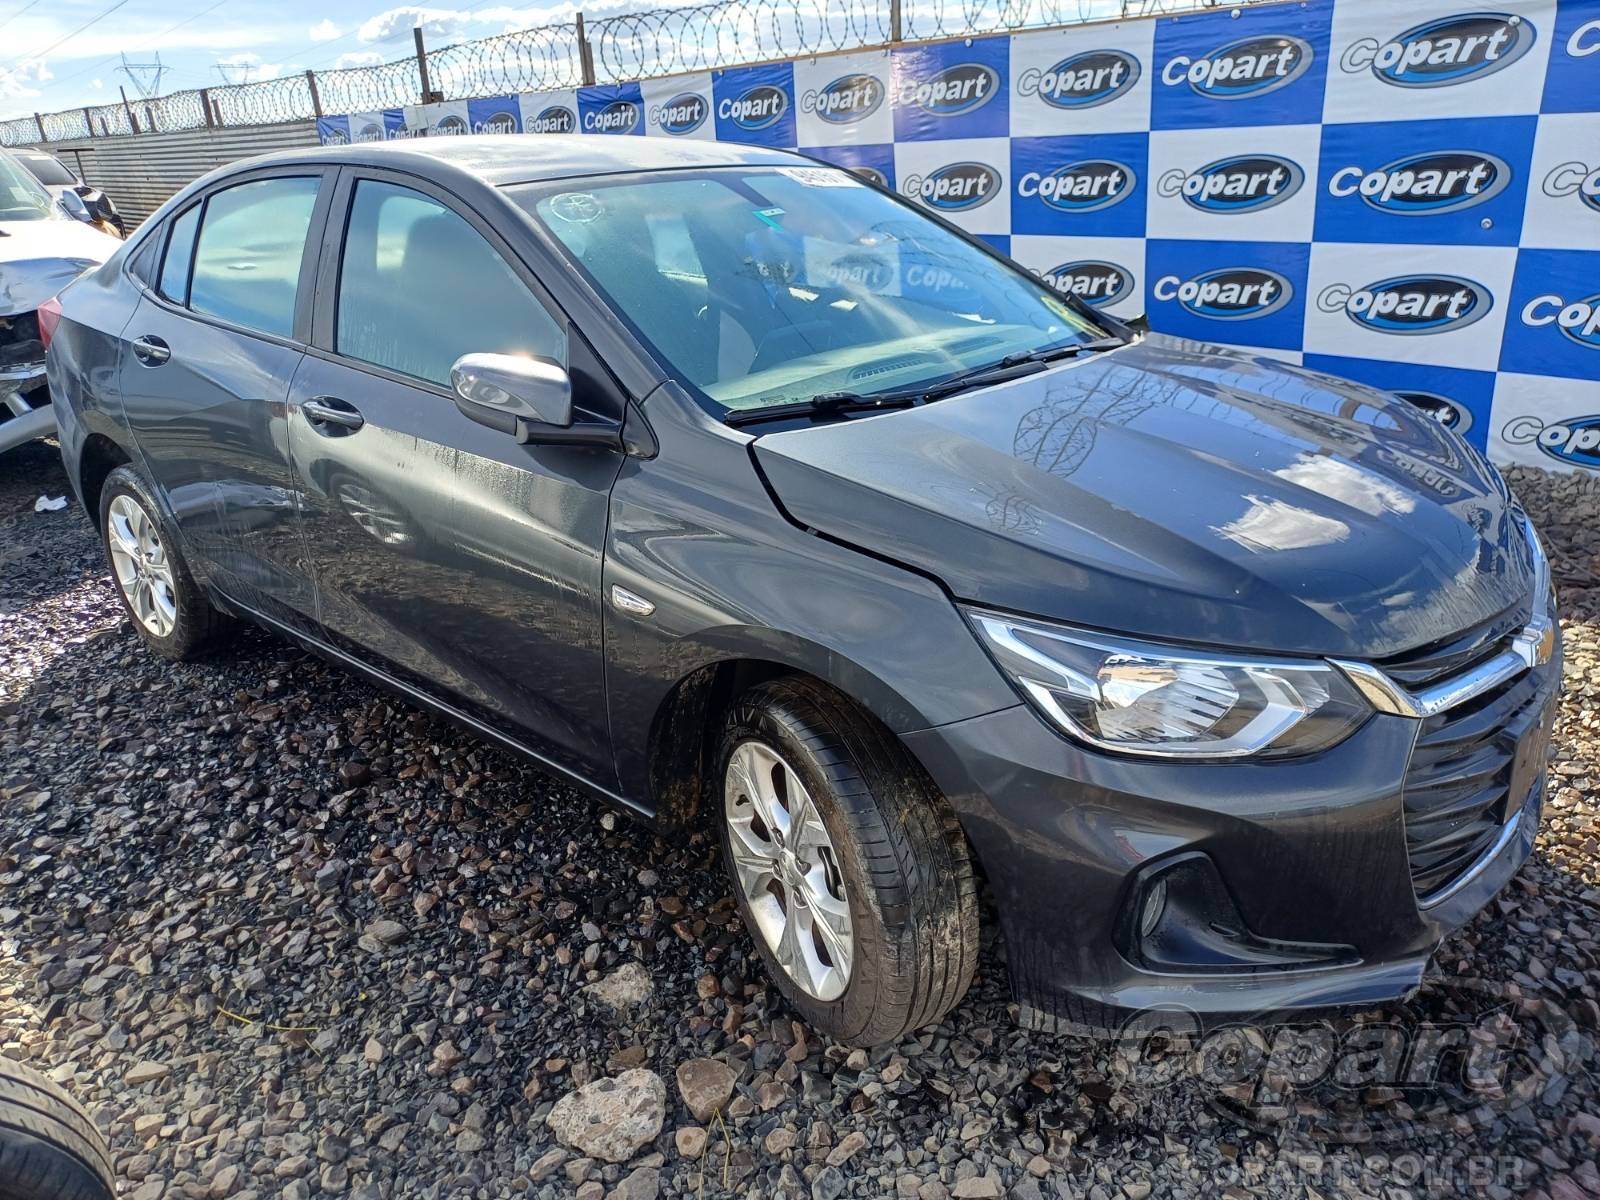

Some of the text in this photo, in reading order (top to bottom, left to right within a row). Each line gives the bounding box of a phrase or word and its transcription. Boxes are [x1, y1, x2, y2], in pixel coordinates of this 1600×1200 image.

[1161, 44, 1295, 88] Copart
[1339, 25, 1510, 75] Copart
[900, 73, 987, 107] Copart
[1017, 59, 1126, 98] Copart
[650, 101, 701, 127] Copart
[718, 93, 781, 121] Copart
[800, 82, 875, 115] Copart
[474, 119, 513, 134] Copart
[526, 113, 570, 133] Copart
[585, 106, 634, 131] Copart
[903, 167, 989, 204] Copart
[1018, 163, 1124, 201] Copart
[1157, 163, 1287, 201] Copart
[1328, 161, 1492, 202] Copart
[1153, 275, 1276, 307] Copart
[1316, 282, 1471, 320] Copart
